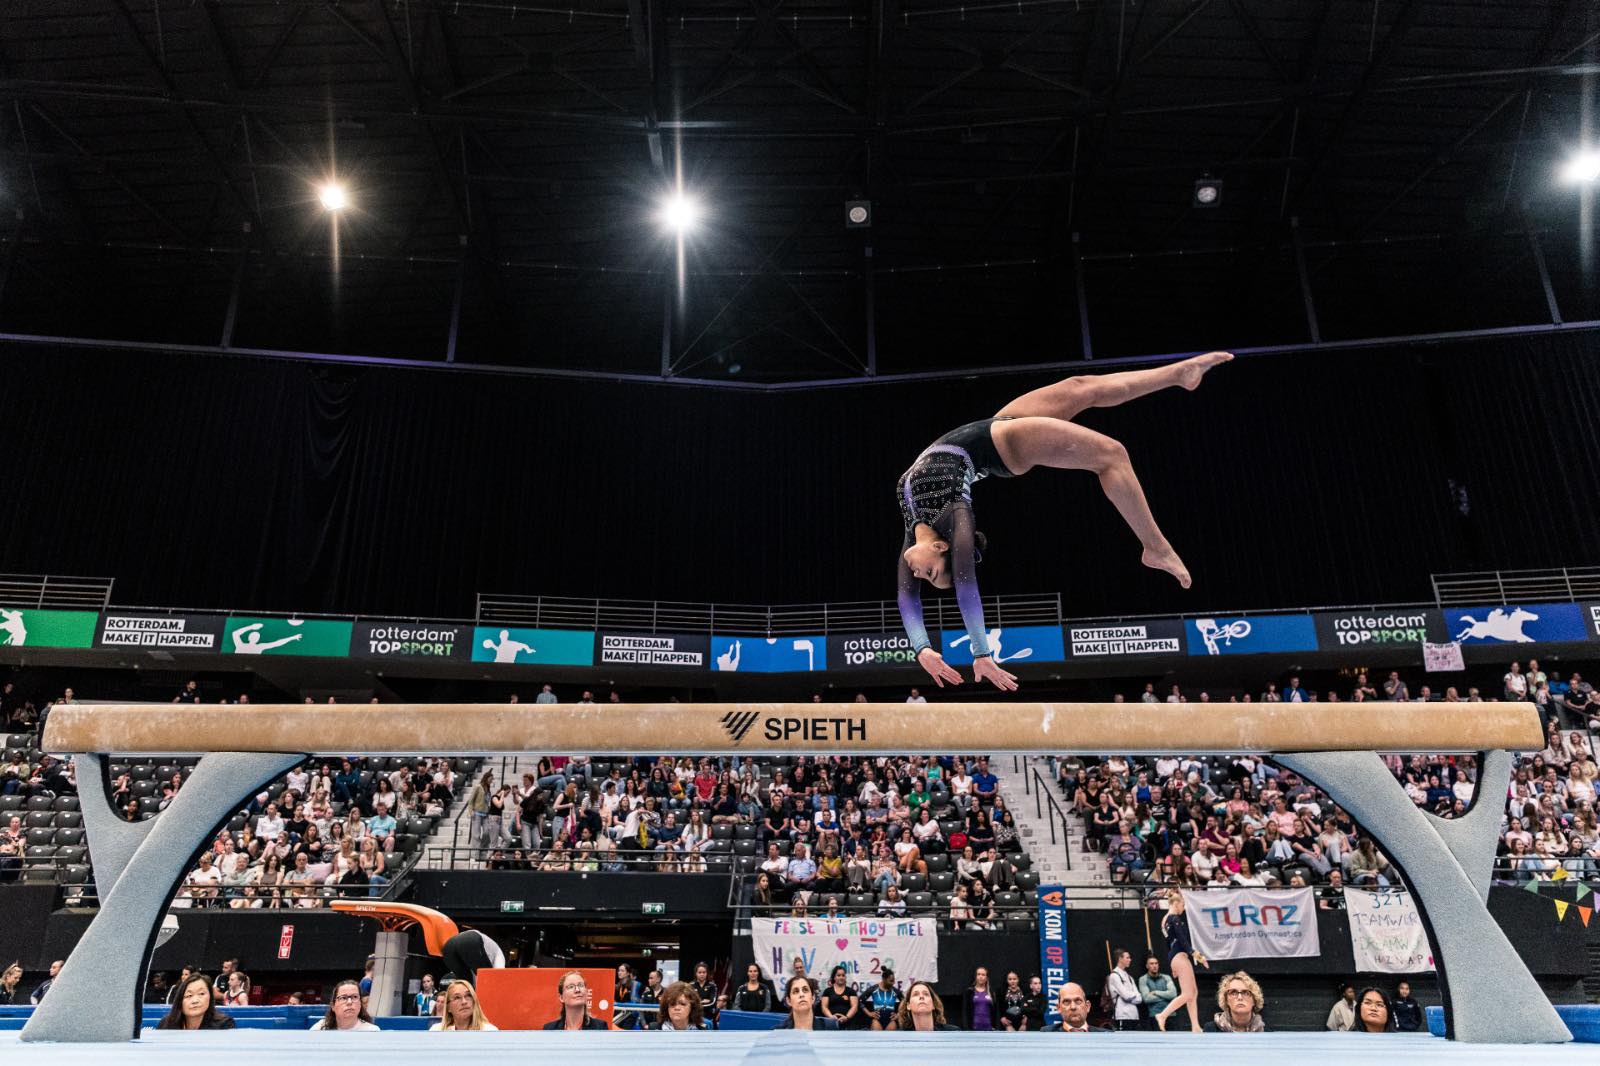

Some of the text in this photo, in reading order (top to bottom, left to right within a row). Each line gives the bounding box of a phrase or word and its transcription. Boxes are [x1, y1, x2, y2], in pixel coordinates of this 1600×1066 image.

[108, 619, 182, 630] ROTTERDAM.
[1334, 614, 1426, 630] rotterdam
[105, 633, 211, 646] MAKE IT HAPPEN.
[370, 627, 455, 641] rotterdam
[1073, 629, 1144, 640] ROTTERDAM.
[1336, 628, 1427, 645] TOPSPORT
[369, 640, 454, 656] TOPSPORT
[604, 638, 672, 648] ROTTERDAM.
[1074, 640, 1177, 654] MAKE IT HAPPEN.
[604, 651, 701, 664] MAKE IT HAPPEN.
[844, 650, 916, 665] TOPSPOR
[764, 717, 866, 741] SPIETH
[1044, 909, 1062, 940] KOM
[1046, 946, 1063, 965] OP
